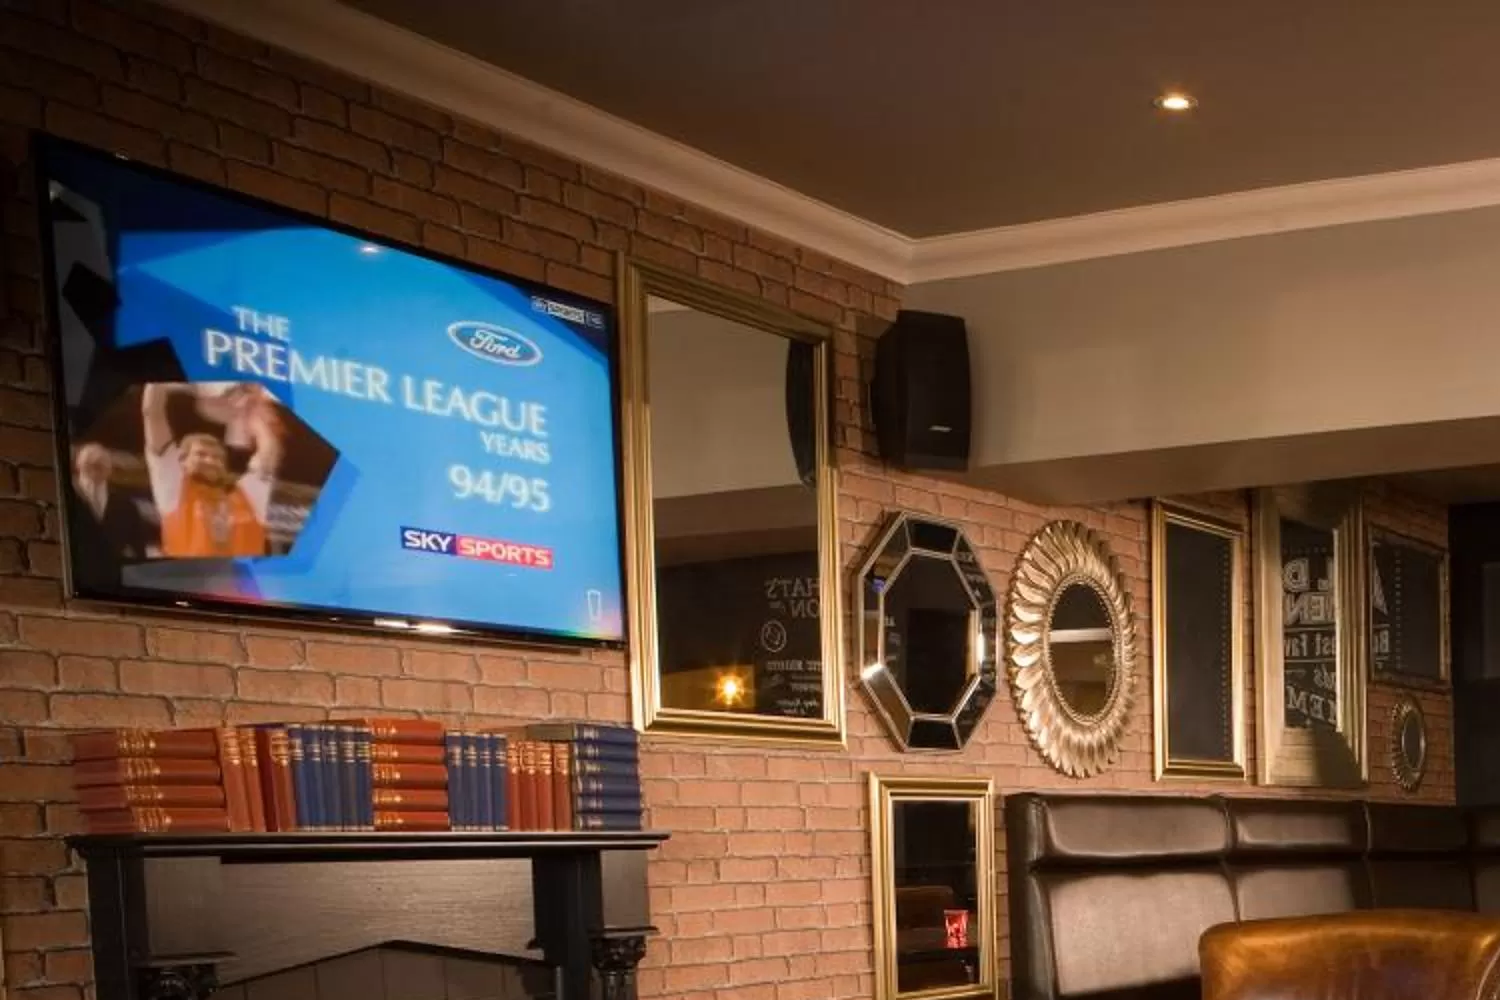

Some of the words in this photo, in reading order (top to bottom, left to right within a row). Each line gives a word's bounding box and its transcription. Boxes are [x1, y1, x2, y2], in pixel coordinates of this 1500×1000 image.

[232, 305, 290, 341] THE
[467, 327, 523, 360] Ford
[204, 328, 392, 404] PREMIER
[403, 374, 549, 437] LEAGUE
[480, 430, 551, 465] YEARS
[447, 463, 551, 512] 94/95
[403, 528, 452, 554] SKY
[459, 540, 551, 566] SPORTS
